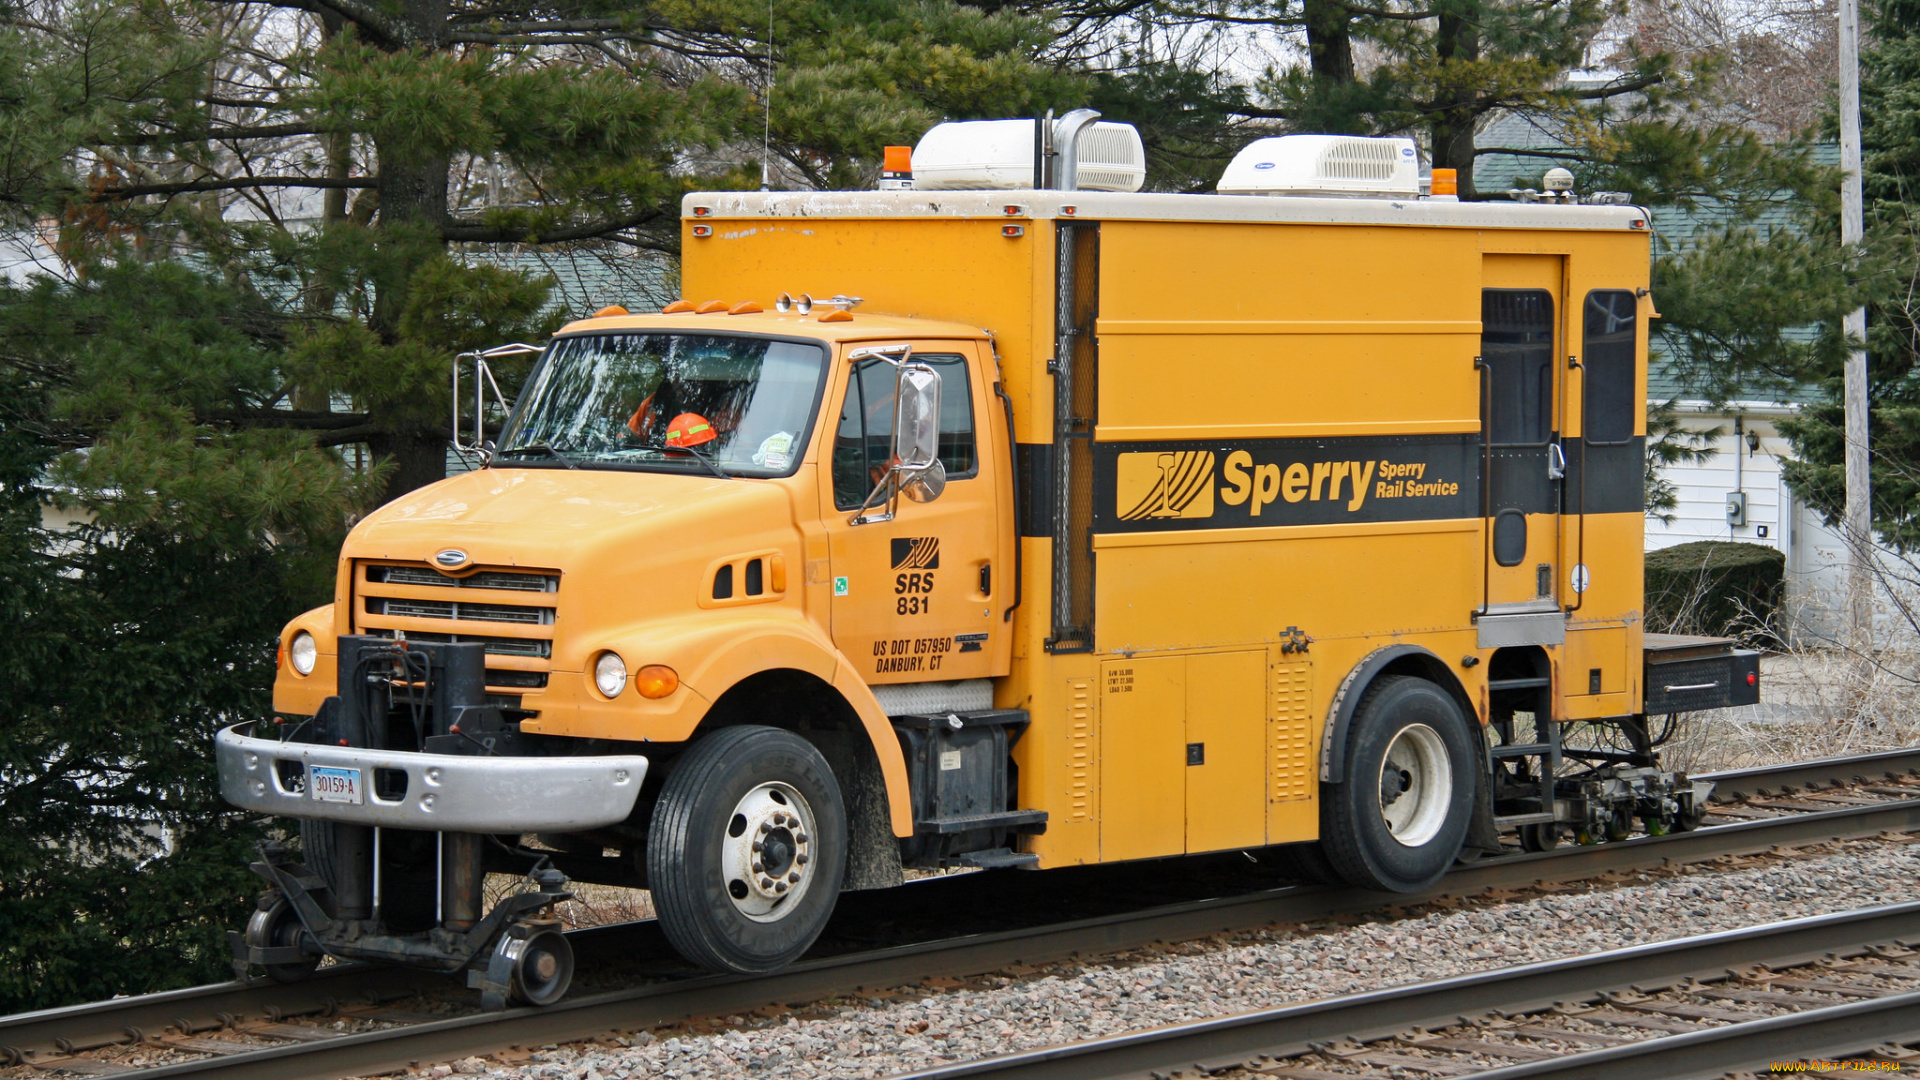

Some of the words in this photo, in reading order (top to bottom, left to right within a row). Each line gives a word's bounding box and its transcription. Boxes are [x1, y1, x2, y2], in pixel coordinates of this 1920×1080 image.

[1378, 460, 1426, 479] Sperry
[1220, 450, 1376, 516] Sperry
[1376, 481, 1403, 498] Rail
[1405, 479, 1458, 497] Service
[894, 572, 934, 594] SRS
[896, 596, 929, 615] 831
[873, 641, 886, 656] US
[891, 639, 911, 655] DOT
[914, 638, 951, 654] 057950
[876, 657, 925, 673] DANBURY,
[929, 655, 942, 670] CT
